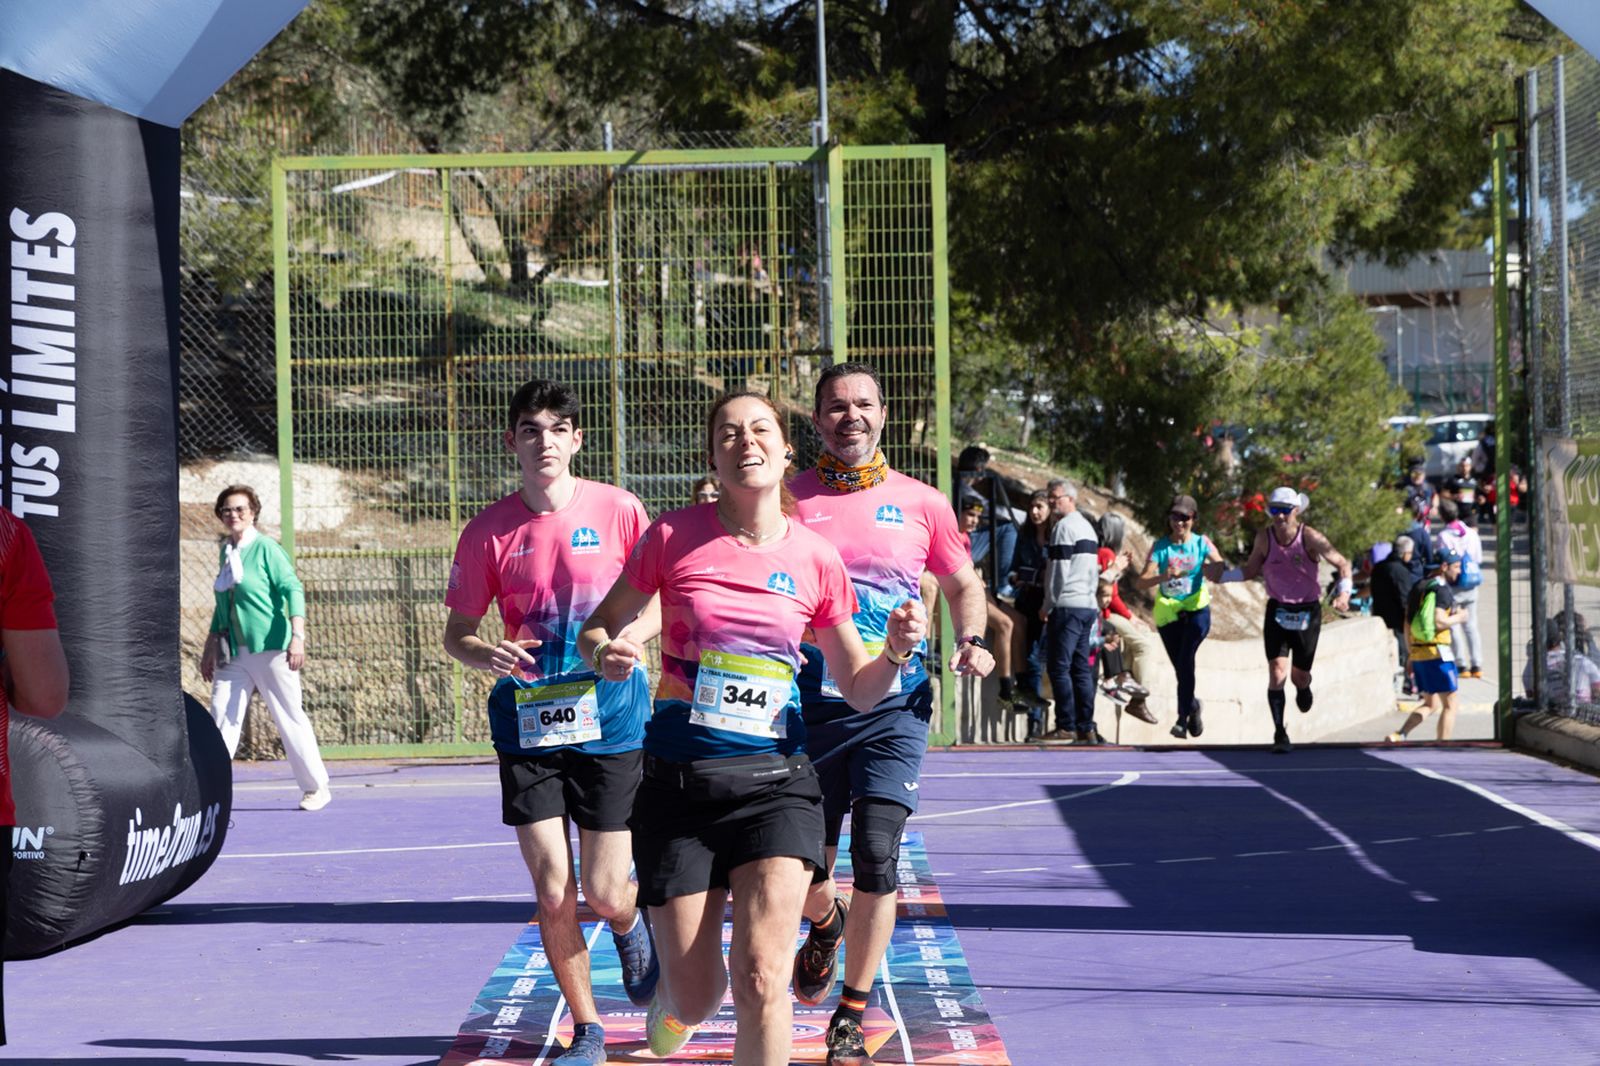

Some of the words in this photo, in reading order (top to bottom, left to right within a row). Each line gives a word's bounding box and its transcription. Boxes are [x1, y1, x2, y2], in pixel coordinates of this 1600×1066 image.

[1, 207, 76, 432] LÍMITES
[10, 442, 60, 518] TUS
[540, 707, 576, 726] 640
[723, 685, 767, 709] 344
